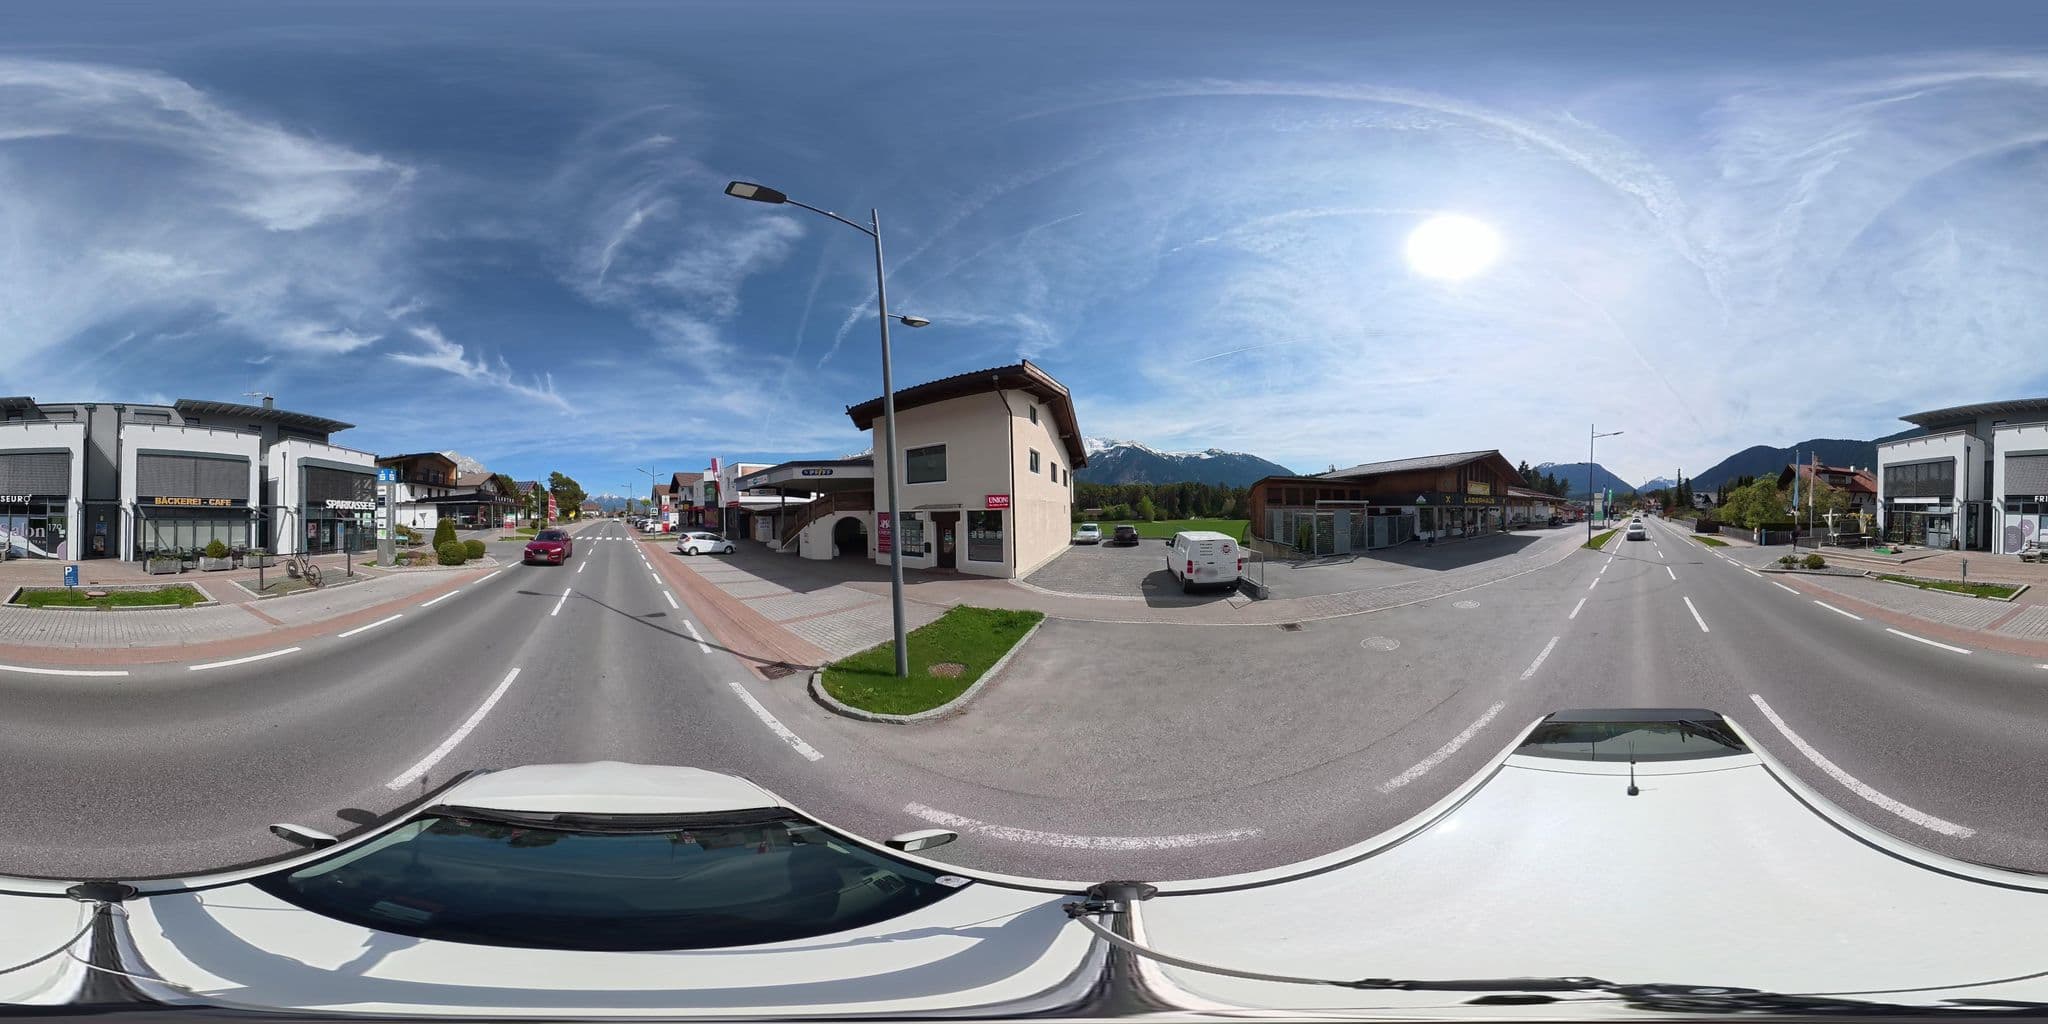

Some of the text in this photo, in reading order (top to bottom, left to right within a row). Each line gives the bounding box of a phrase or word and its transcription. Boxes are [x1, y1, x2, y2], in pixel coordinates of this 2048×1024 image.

[154, 496, 202, 506] BÄCKEREI
[988, 496, 1009, 504] UNION
[2034, 495, 2048, 503] FRI
[325, 499, 369, 510] SPARKASSE
[65, 566, 73, 577] P
